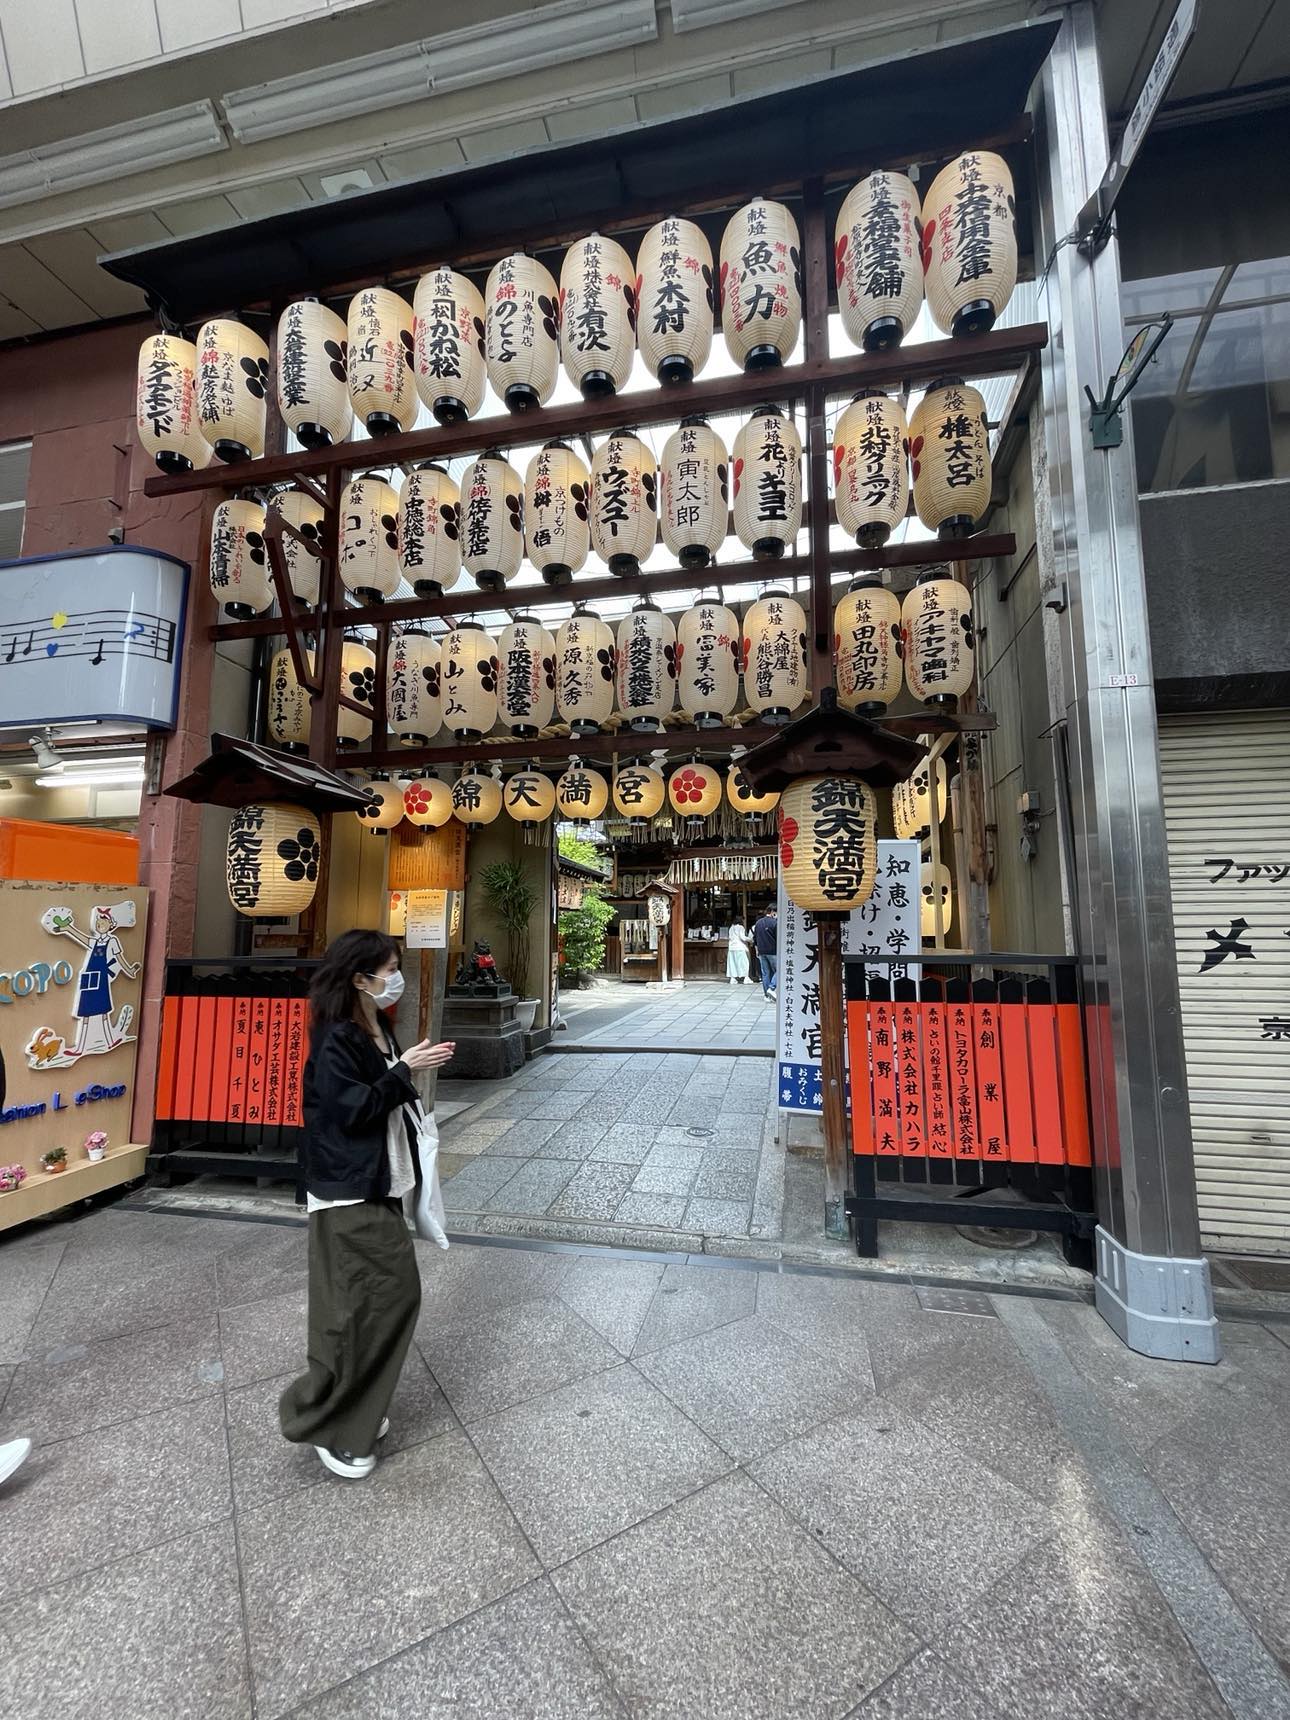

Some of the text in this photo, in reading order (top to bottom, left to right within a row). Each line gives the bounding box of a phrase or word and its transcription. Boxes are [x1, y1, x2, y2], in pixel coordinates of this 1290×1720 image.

[953, 182, 992, 288] 中央信用金庫
[993, 183, 1008, 221] 京都
[740, 240, 776, 325] 魚力
[282, 329, 310, 409] 大岩建設工業
[601, 466, 630, 537] ウィズユー
[675, 458, 701, 528] 寅太郎
[859, 426, 892, 507] 北村クリニック
[553, 486, 567, 537] 京つけもの
[506, 649, 532, 717] 阪本漢方堂
[851, 625, 879, 691] 田丸印房
[919, 610, 949, 684] アキヤマ歯科
[444, 659, 468, 717] 山とみ
[451, 770, 650, 812] 錦 天 満 宮
[228, 806, 264, 907] 錦天満宮
[811, 778, 866, 901] 錦天満宮
[928, 1007, 939, 1026] 奉納
[954, 1008, 966, 1027] 奉納
[230, 1019, 247, 1119] 夏目千夏
[798, 1067, 808, 1105] おみくじ
[875, 1006, 896, 1152] 奉納 南野満夫
[900, 1007, 921, 1152] 奉納 株式会社カハラ
[980, 1008, 1003, 1156] 奉納 創業屋
